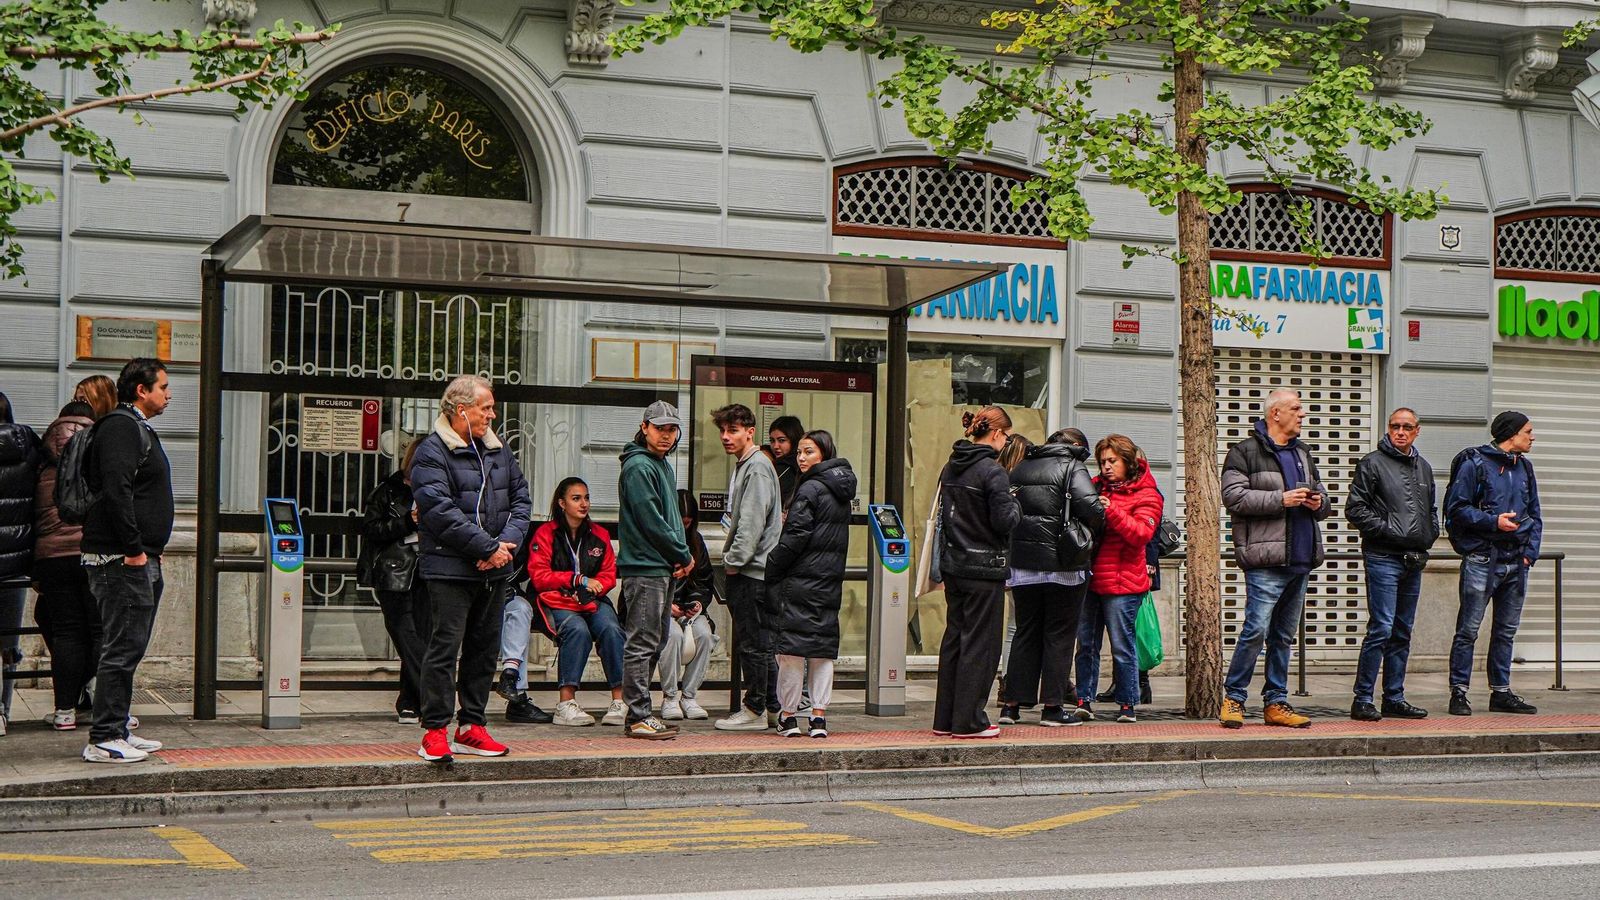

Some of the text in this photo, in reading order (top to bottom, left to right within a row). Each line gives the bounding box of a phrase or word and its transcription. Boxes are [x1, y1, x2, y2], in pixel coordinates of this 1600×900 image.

[306, 90, 493, 169] EDIFICIO PARIS
[397, 202, 411, 222] 7
[1209, 264, 1383, 306] RAFARMACIA
[1212, 317, 1232, 331] an
[1276, 314, 1287, 334] 7
[1499, 285, 1600, 341] llaol
